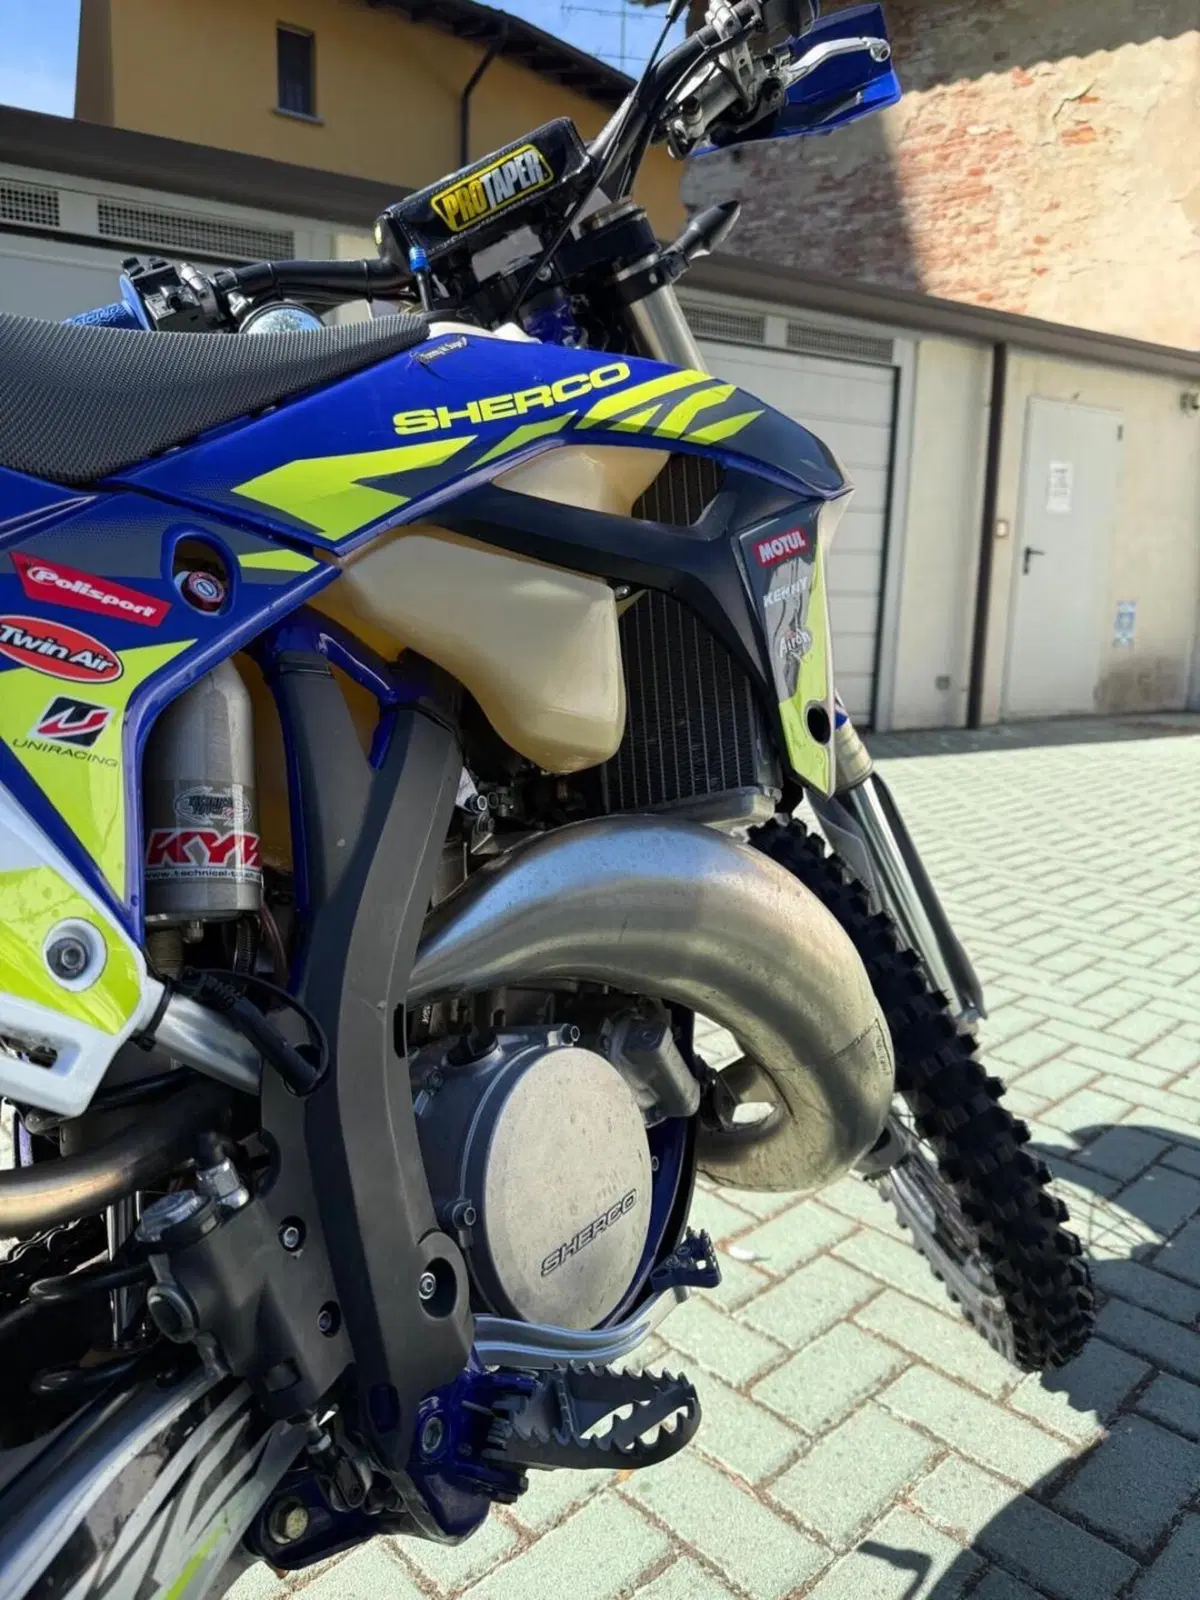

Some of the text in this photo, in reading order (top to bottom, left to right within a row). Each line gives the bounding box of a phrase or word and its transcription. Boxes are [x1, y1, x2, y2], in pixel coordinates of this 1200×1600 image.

[393, 361, 631, 436] SHERCO
[758, 530, 806, 563] MOTUL
[32, 566, 157, 618] Polisport
[763, 577, 808, 608] KENNY
[0, 624, 115, 673] Twin Air
[12, 738, 119, 768] UNIRACING
[540, 1188, 638, 1278] SHERCO
